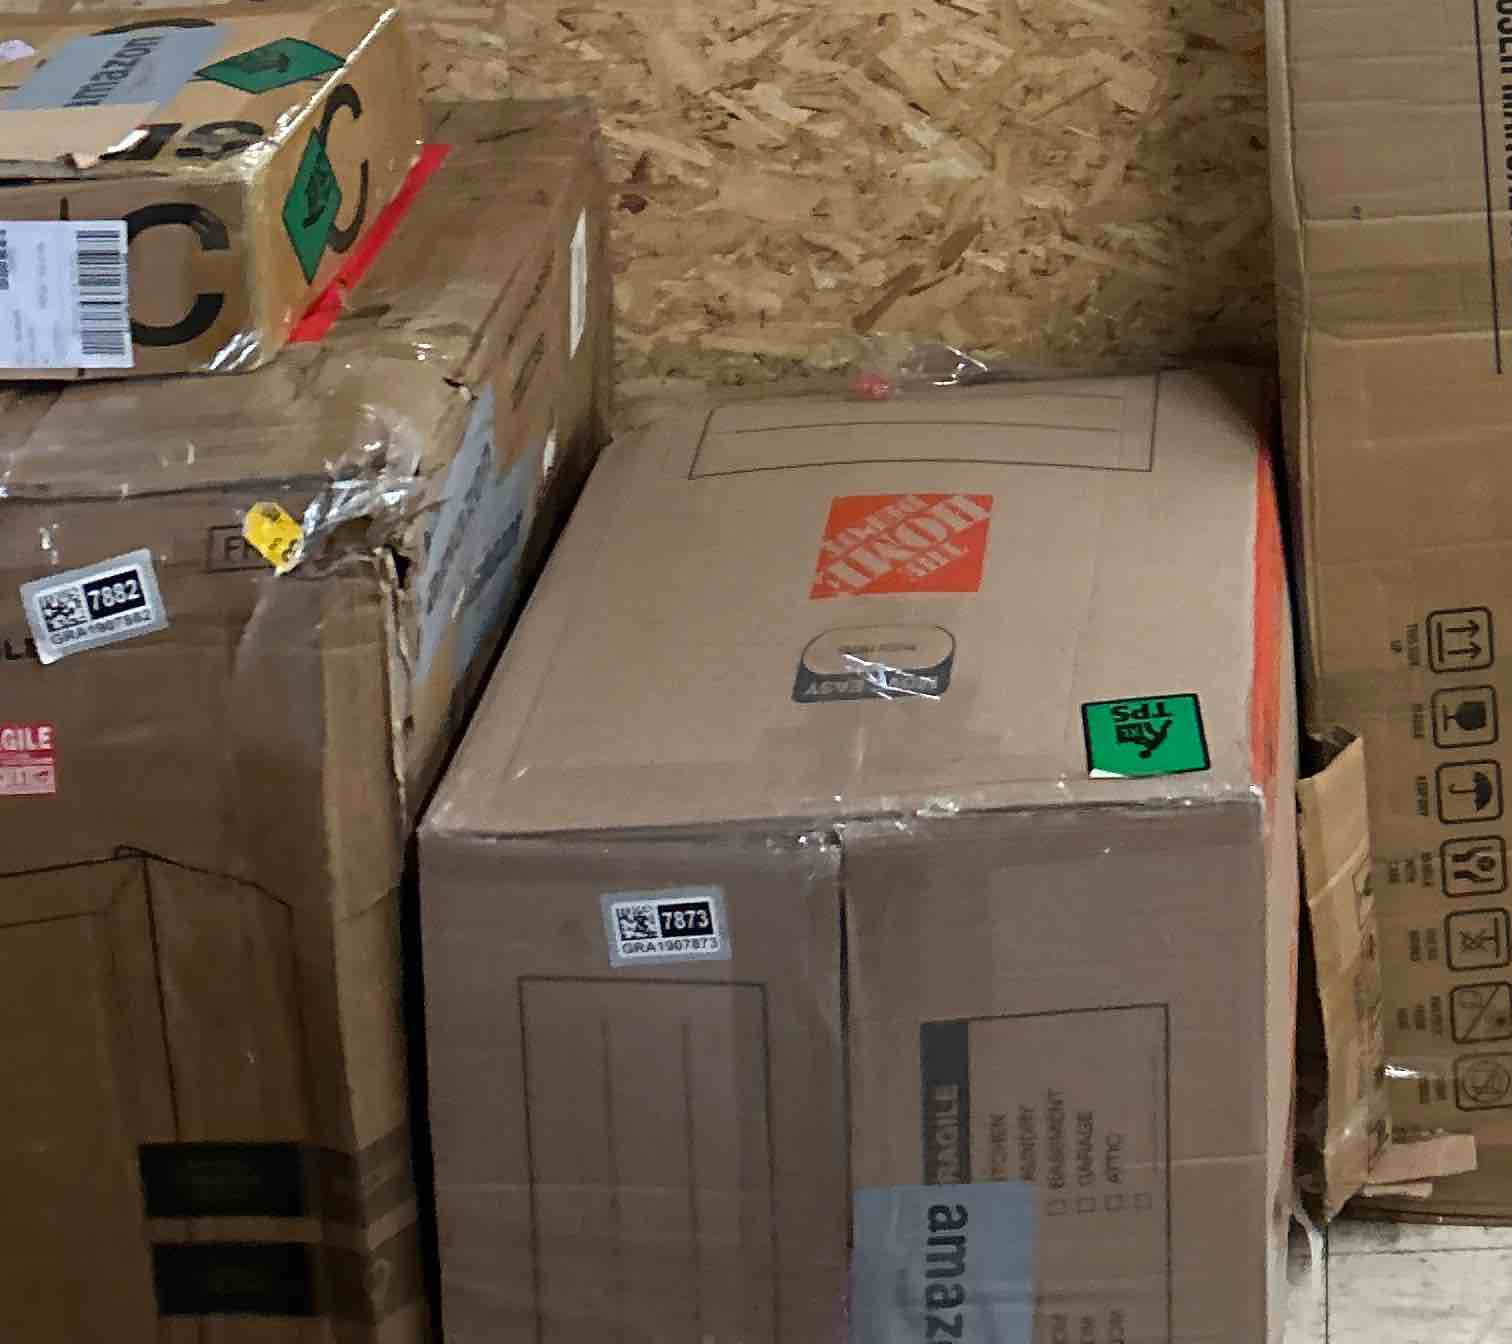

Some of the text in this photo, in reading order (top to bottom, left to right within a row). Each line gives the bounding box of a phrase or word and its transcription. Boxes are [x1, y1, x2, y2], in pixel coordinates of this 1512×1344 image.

[63, 36, 163, 107] mazon
[87, 579, 140, 611] 7882
[1110, 702, 1174, 722] TPS
[0, 725, 53, 750] GILE
[661, 910, 709, 930] 7873
[932, 1083, 961, 1185] RAGILE
[1105, 1134, 1122, 1184] ATTIC
[924, 1204, 968, 1344] amaz
